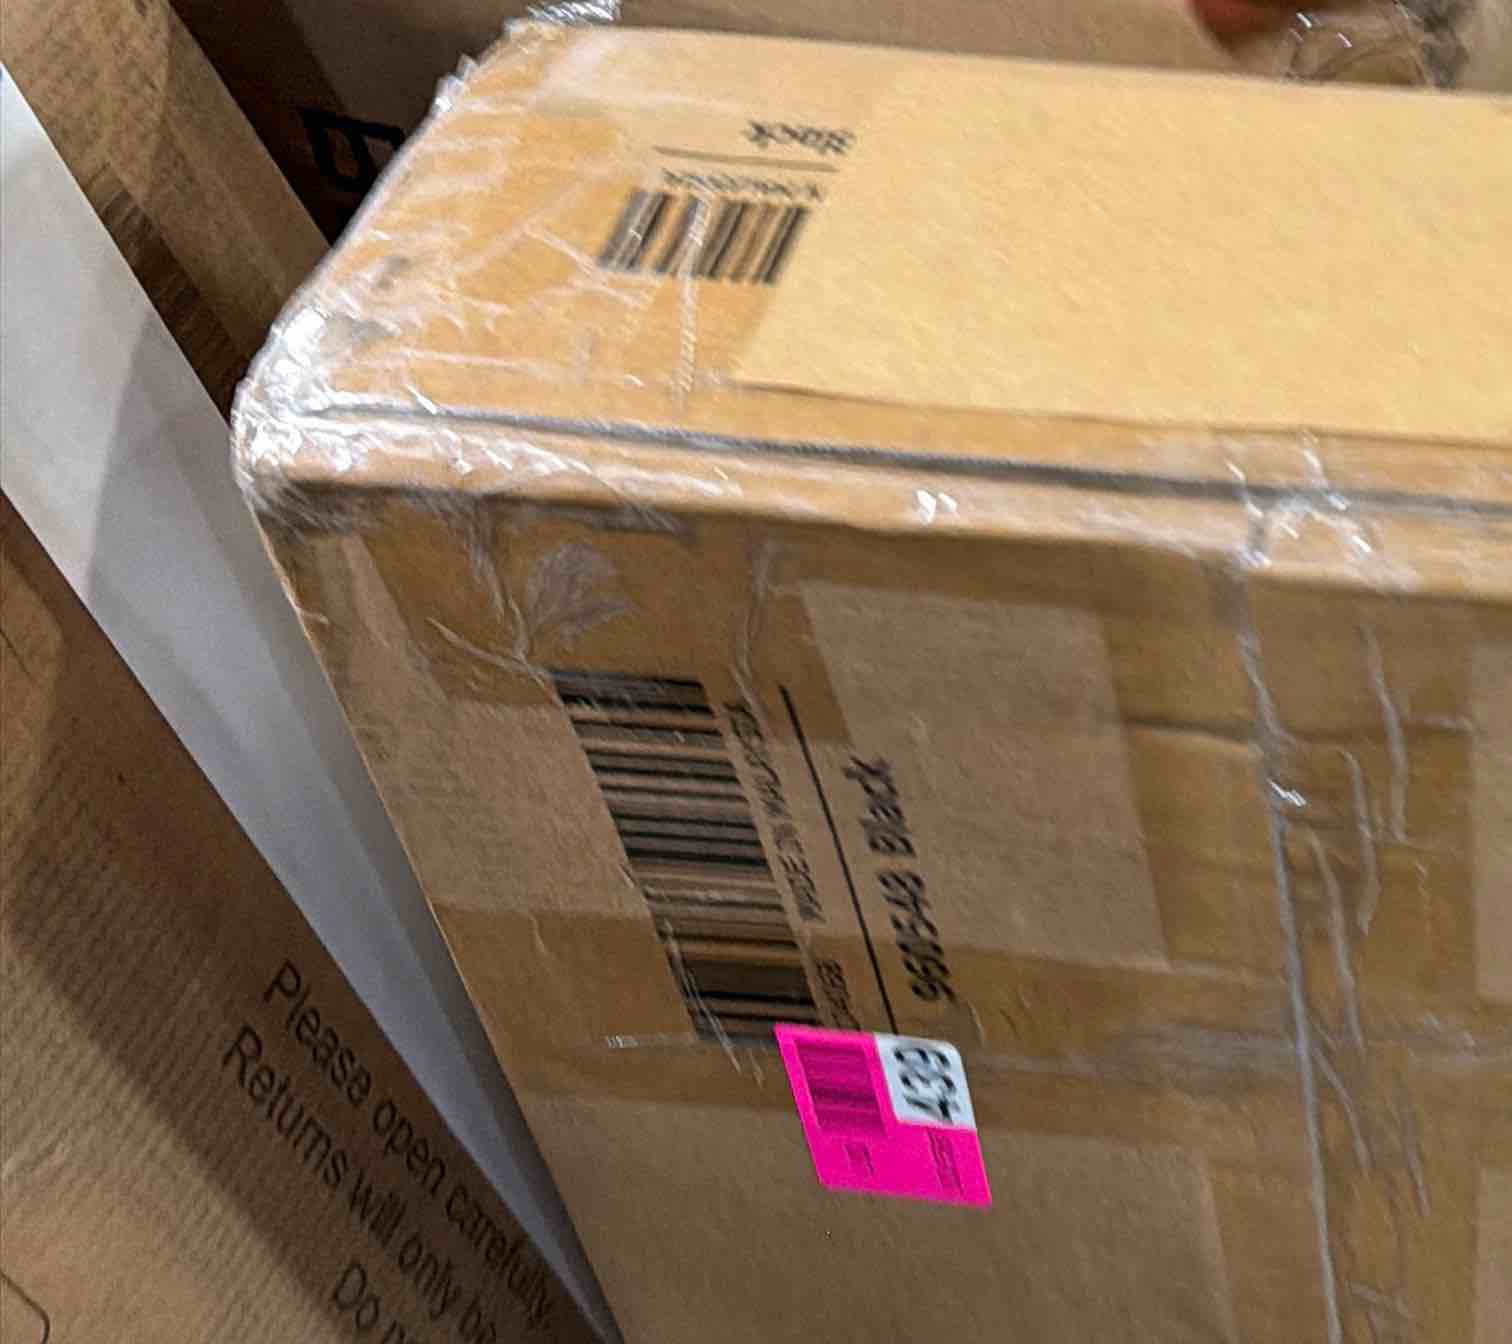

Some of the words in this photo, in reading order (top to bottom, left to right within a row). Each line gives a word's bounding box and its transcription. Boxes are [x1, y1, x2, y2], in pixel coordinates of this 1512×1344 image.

[222, 1024, 349, 1187] Returns
[349, 1169, 408, 1244] will
[399, 1233, 460, 1321] only
[263, 958, 371, 1108] Please
[373, 1099, 447, 1197] open
[331, 1259, 379, 1331] Do
